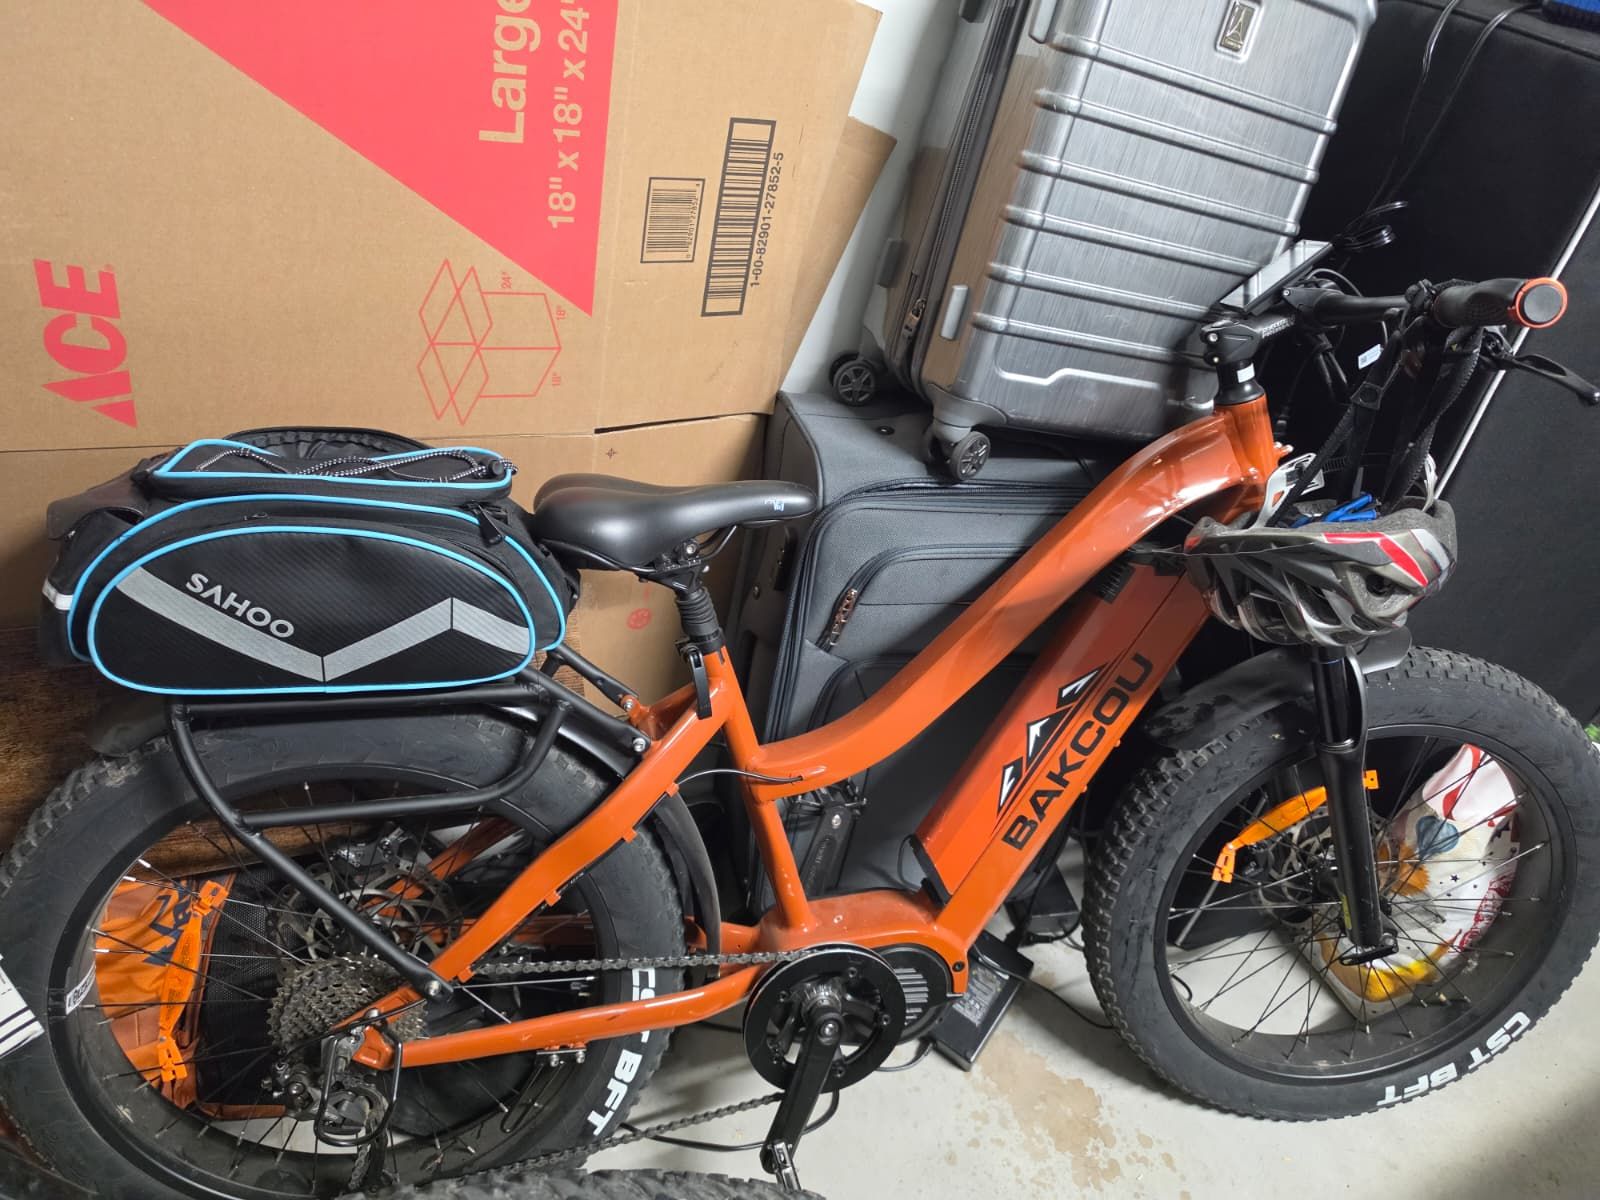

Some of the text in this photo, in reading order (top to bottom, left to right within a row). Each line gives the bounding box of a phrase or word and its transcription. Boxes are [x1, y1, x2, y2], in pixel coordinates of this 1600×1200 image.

[562, 58, 586, 81] x
[553, 86, 582, 143] 18"
[558, 150, 580, 171] x
[547, 177, 576, 229] 18"
[750, 152, 784, 287] 1-00-82901-27852-5
[34, 259, 138, 428] ACE
[186, 573, 295, 638] SAHOO
[1001, 653, 1154, 850] BAKCOU
[587, 1049, 643, 1136] BFT
[1376, 1011, 1531, 1106] CST BFT
